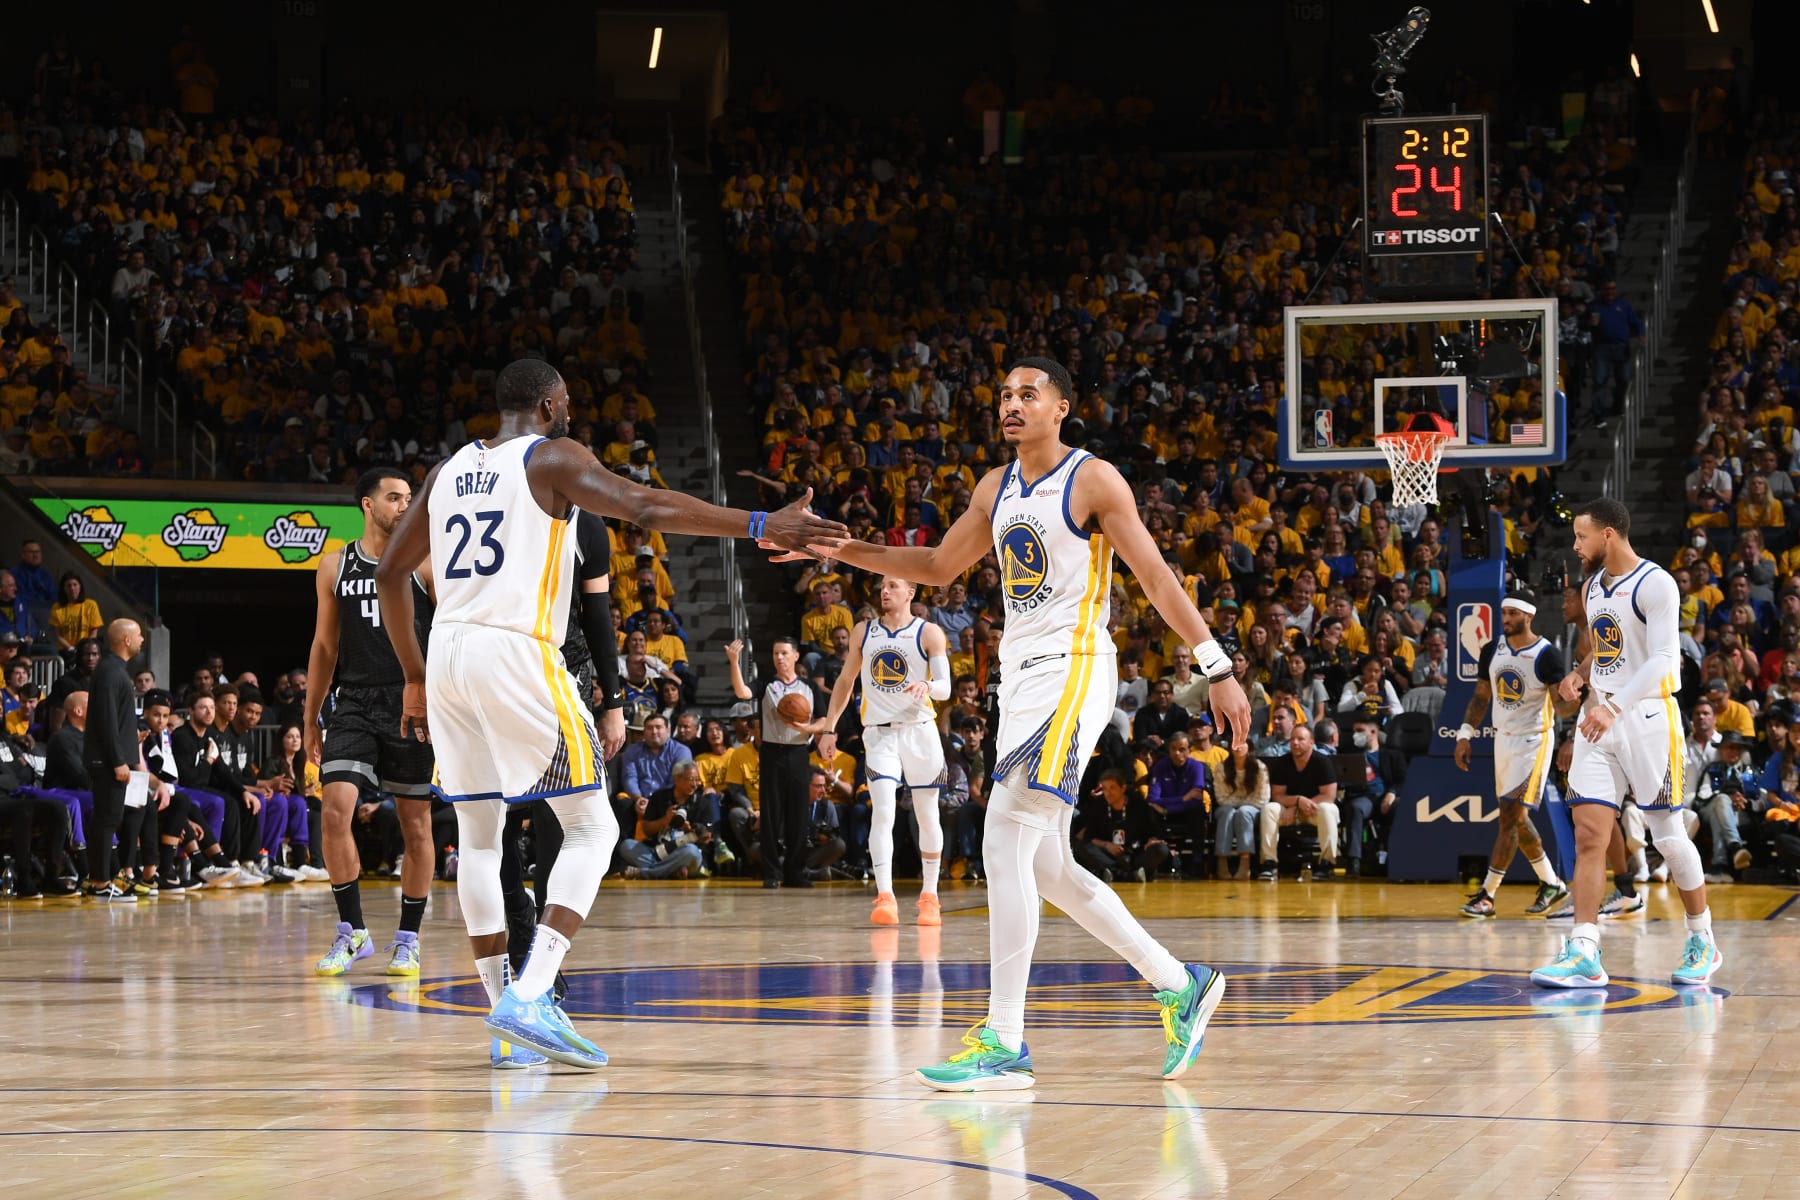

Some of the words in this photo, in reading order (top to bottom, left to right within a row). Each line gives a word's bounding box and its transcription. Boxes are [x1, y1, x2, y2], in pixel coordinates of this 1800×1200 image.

[1402, 127, 1470, 160] 2:12
[1391, 164, 1462, 217] 24
[1402, 227, 1481, 244] TISSOT
[455, 471, 500, 498] GREEN
[60, 512, 124, 550] Starry
[162, 514, 228, 553] Starry
[264, 516, 329, 555] Starry
[1026, 514, 1047, 537] STATE
[445, 510, 505, 580] 23
[1024, 542, 1035, 564] 3
[341, 578, 378, 597] KIN
[1603, 626, 1619, 642] 30
[893, 658, 902, 670] 0
[1511, 678, 1520, 690] 8
[1438, 726, 1481, 738] Goe
